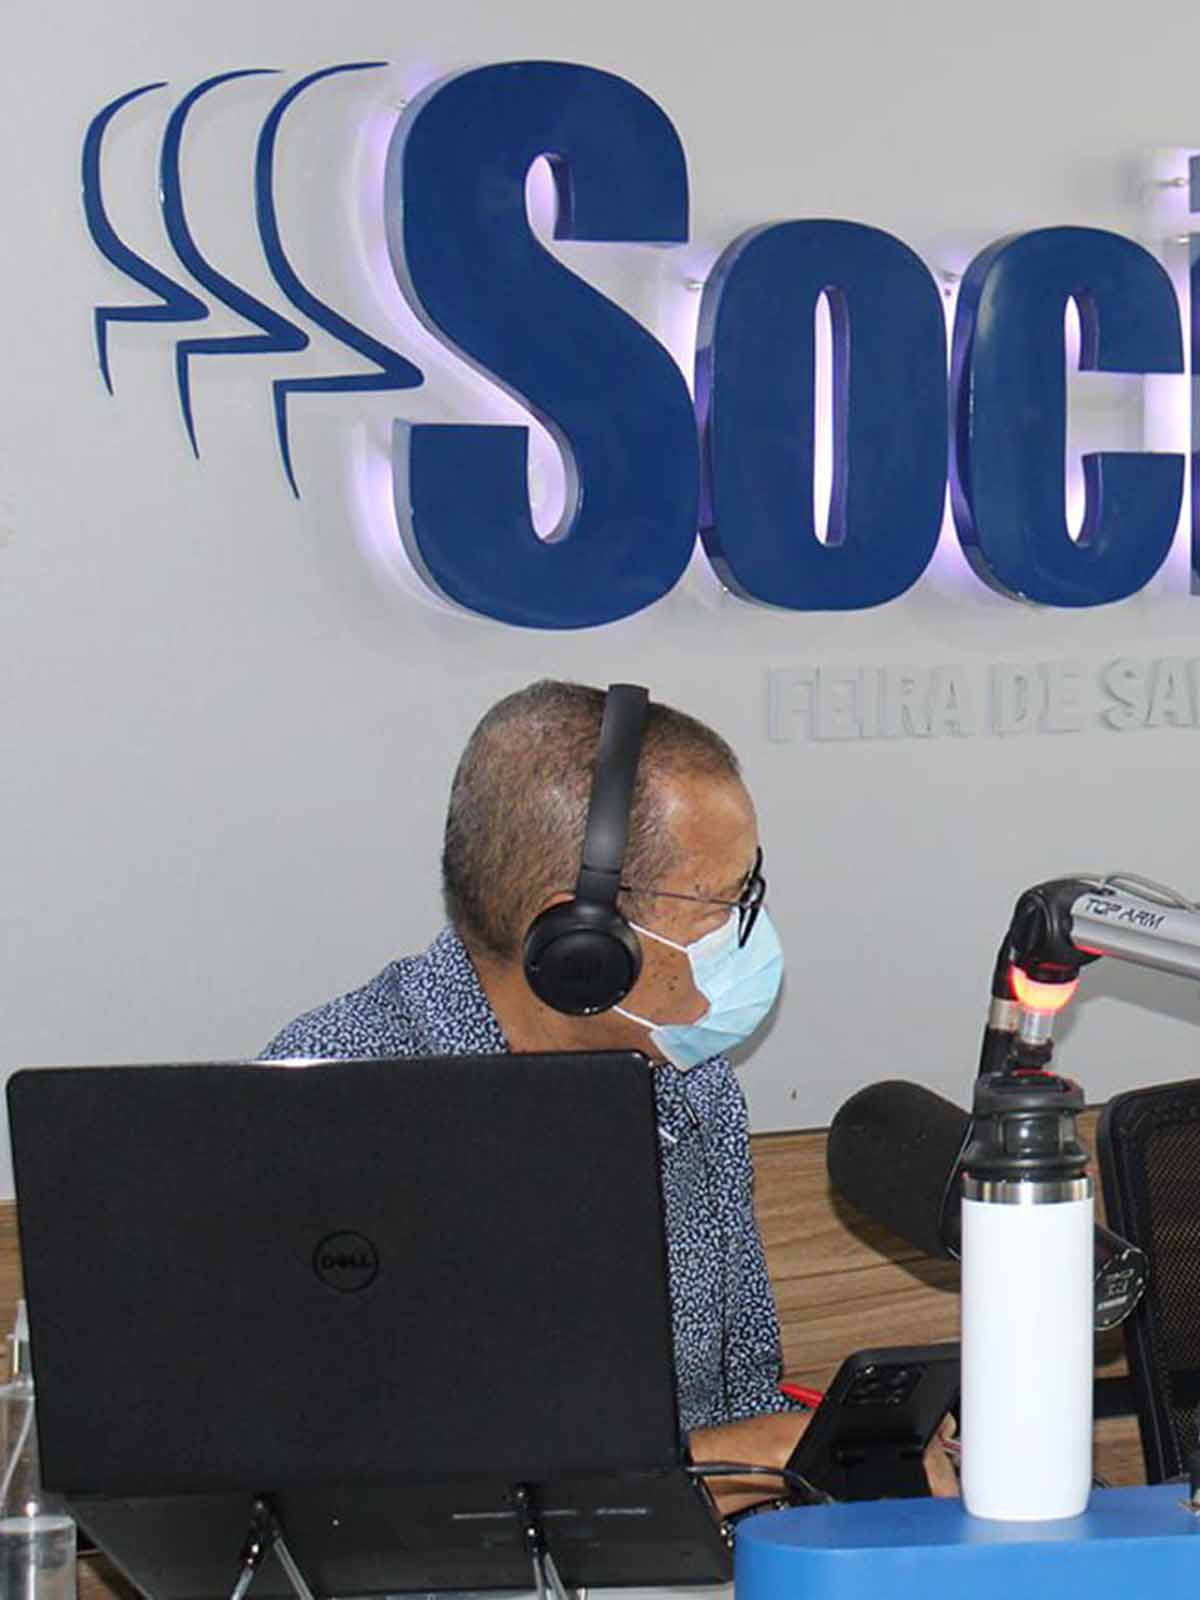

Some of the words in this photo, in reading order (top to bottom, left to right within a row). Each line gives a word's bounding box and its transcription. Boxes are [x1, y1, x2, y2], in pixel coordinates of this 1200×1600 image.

[764, 662, 968, 743] FEIRA
[984, 659, 1083, 737] DE
[1086, 897, 1122, 915] TOP
[1118, 908, 1165, 930] ARM
